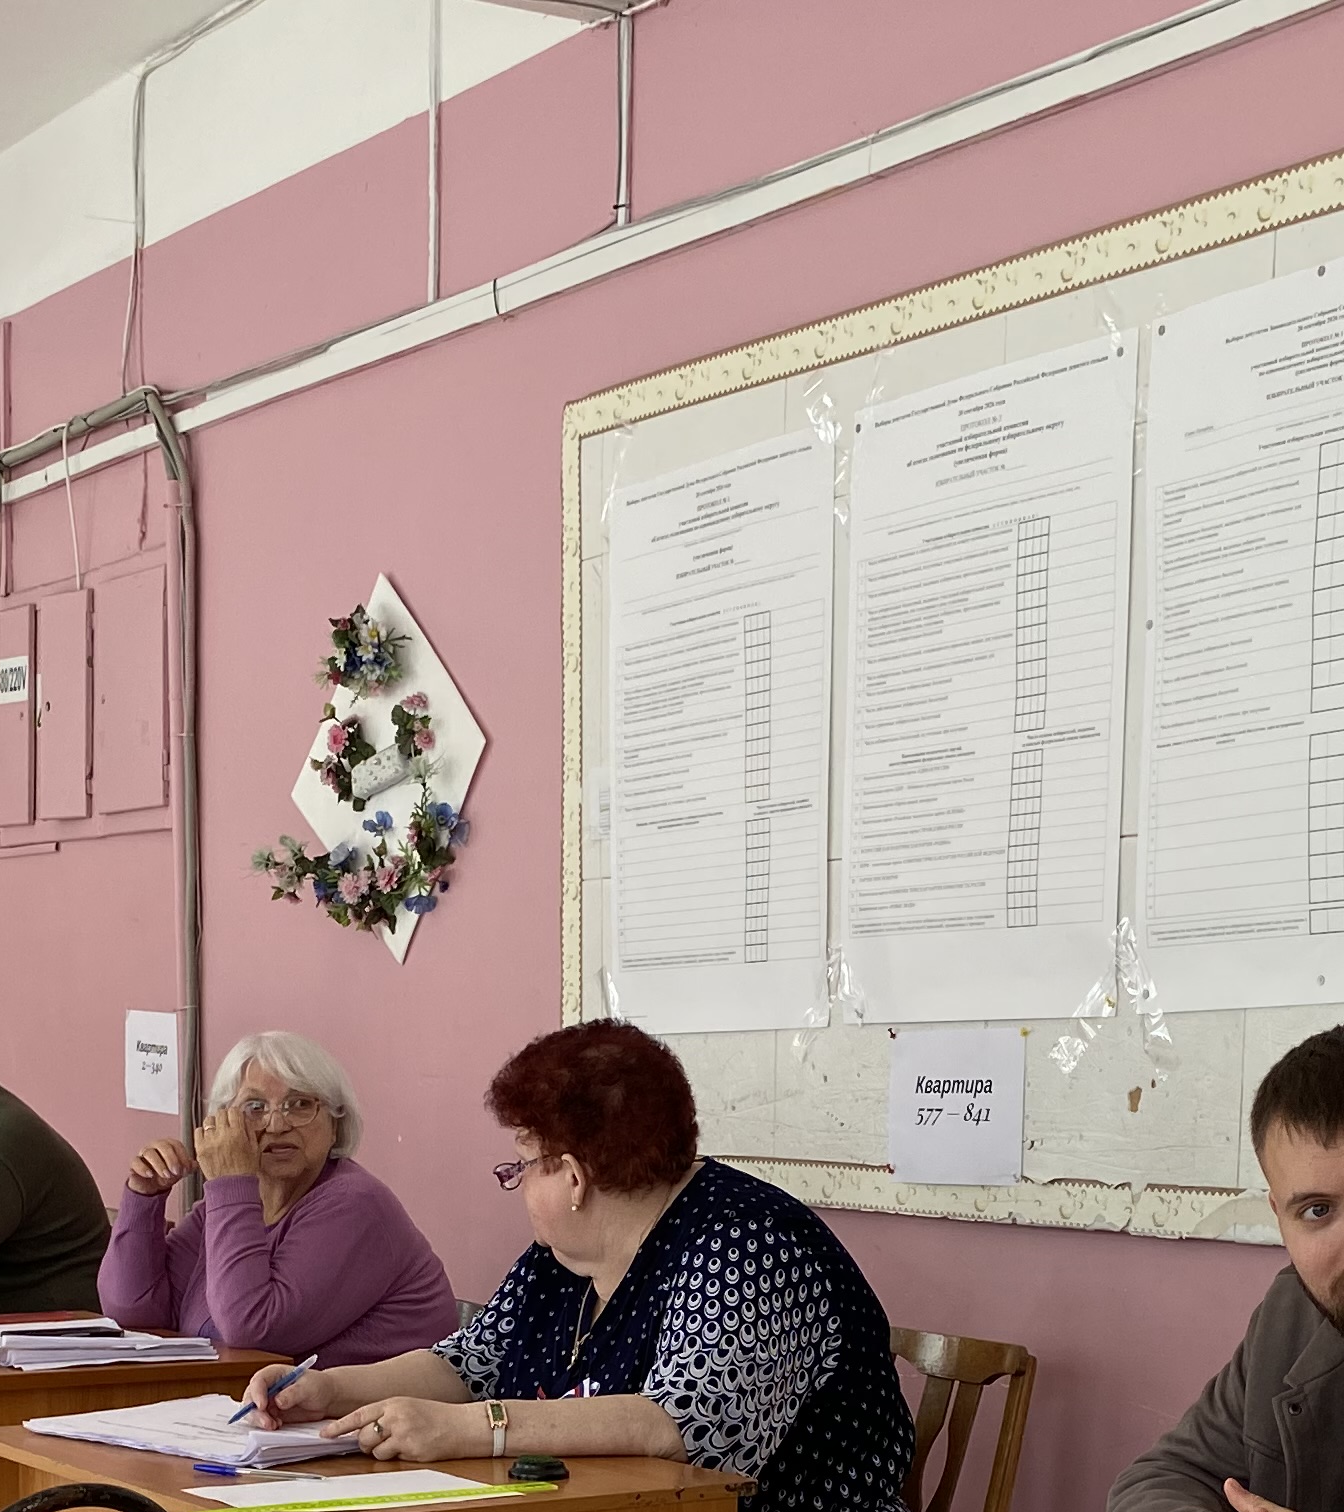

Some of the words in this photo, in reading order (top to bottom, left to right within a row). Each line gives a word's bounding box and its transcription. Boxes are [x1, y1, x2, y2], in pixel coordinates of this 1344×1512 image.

[136, 1040, 168, 1056] Квартира
[915, 1075, 993, 1098] Квартира
[914, 1107, 944, 1126] 577
[963, 1102, 991, 1126] 841
